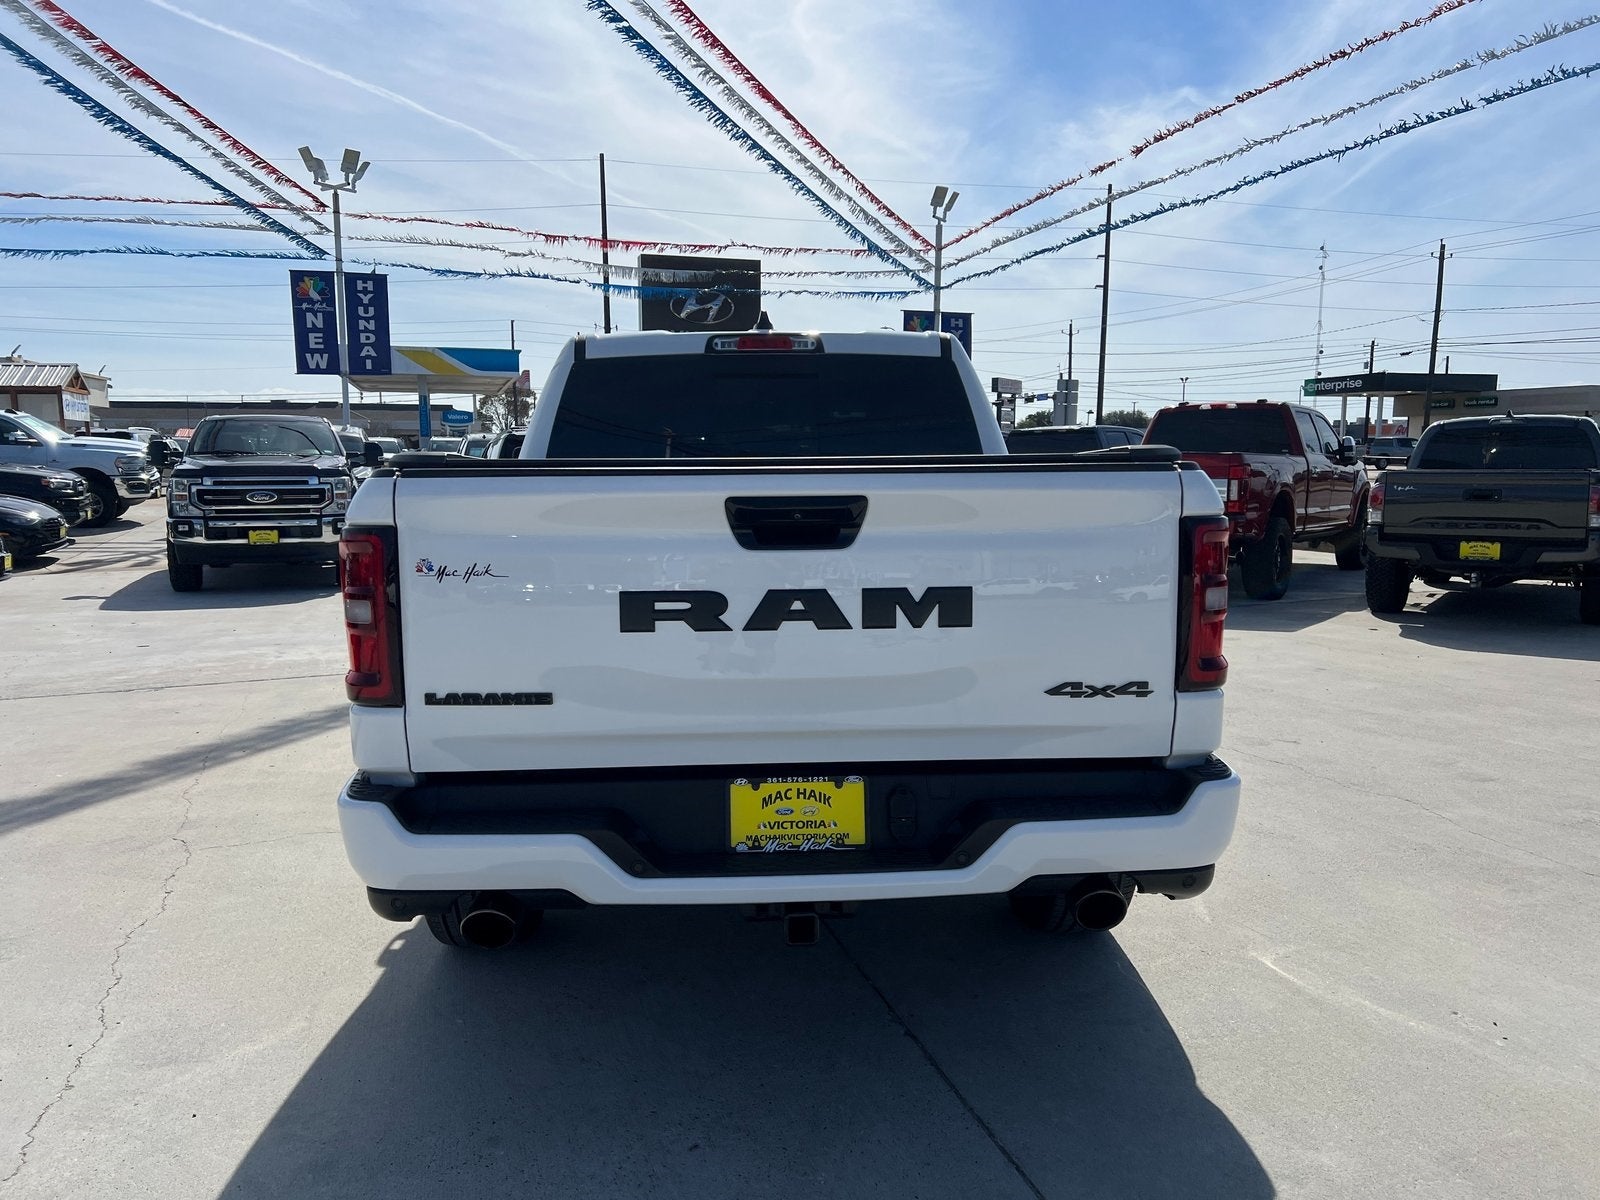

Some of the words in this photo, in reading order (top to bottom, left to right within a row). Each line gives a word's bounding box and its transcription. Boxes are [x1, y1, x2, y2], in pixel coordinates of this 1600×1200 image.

[356, 280, 377, 370] HYUNDAI
[305, 312, 328, 369] NEW
[1307, 378, 1362, 392] enterprise
[1428, 521, 1541, 530] TACOMA
[435, 564, 462, 583] Mac
[463, 562, 509, 583] Haik
[619, 586, 974, 633] RAM
[1044, 681, 1155, 698] 4x4
[424, 692, 553, 706] LARAMIE
[761, 788, 793, 809] MAC
[796, 787, 832, 808] HAIK
[767, 820, 828, 830] VICTORIA
[745, 832, 850, 842] MACHAIKVICTORIA.COM
[762, 838, 798, 853] Mac
[799, 837, 848, 852] Haik
